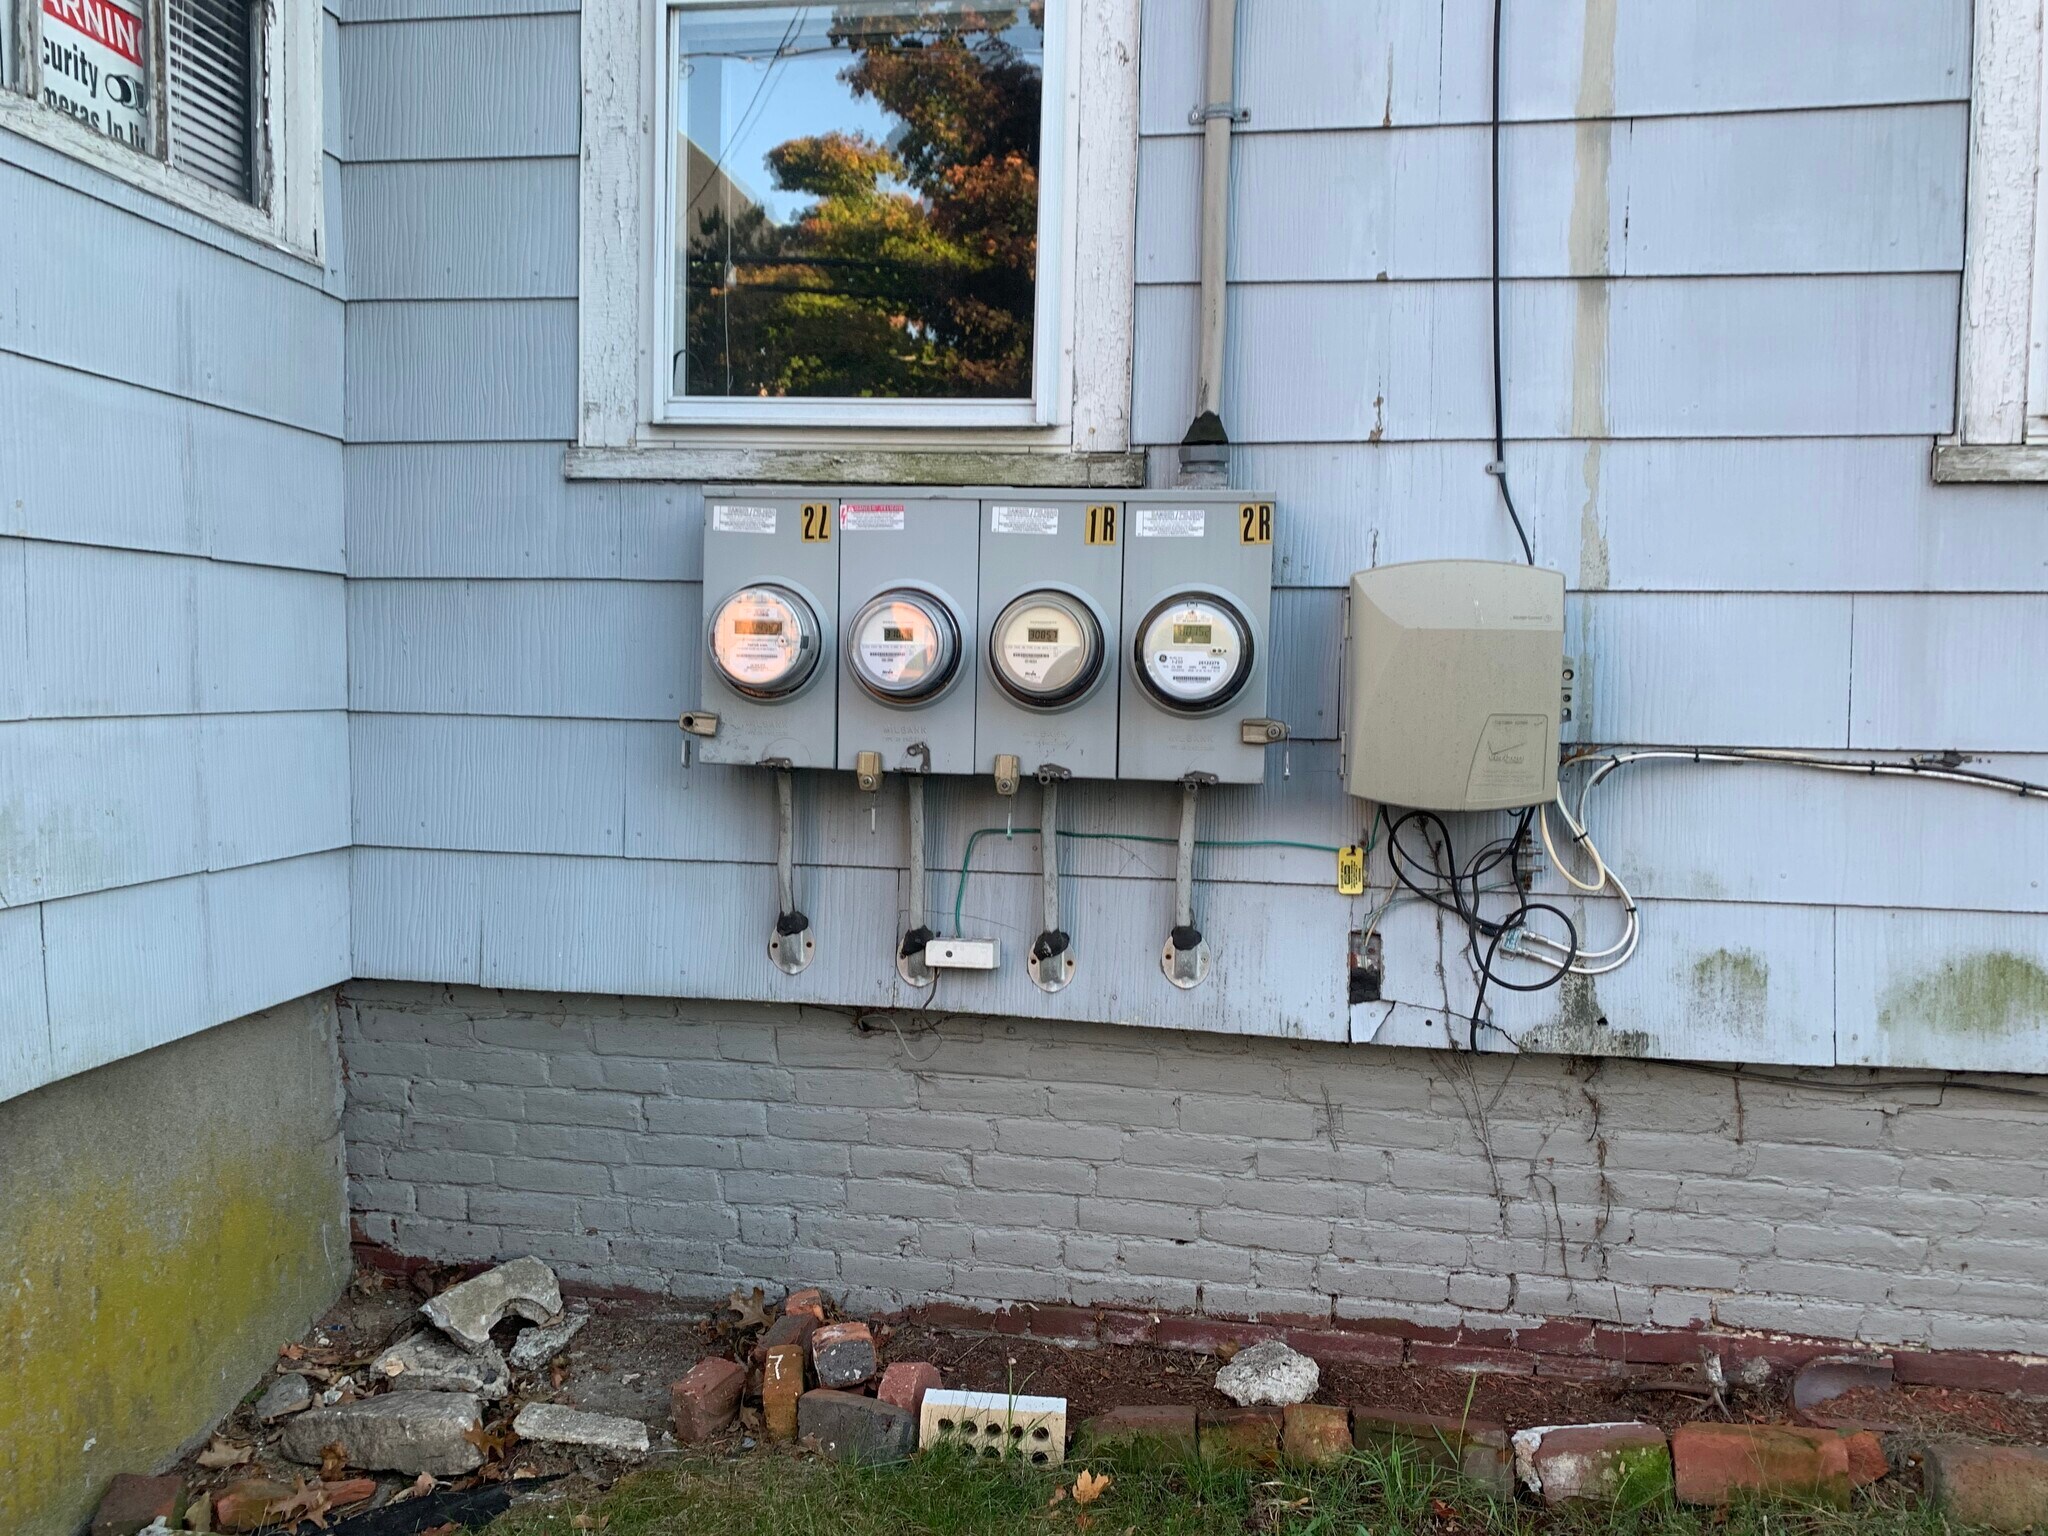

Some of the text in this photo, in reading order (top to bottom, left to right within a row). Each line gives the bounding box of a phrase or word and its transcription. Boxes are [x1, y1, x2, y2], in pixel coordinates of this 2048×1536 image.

[1090, 506, 1115, 543] 1R
[1243, 505, 1270, 542] 2R
[769, 1354, 783, 1380] 7
